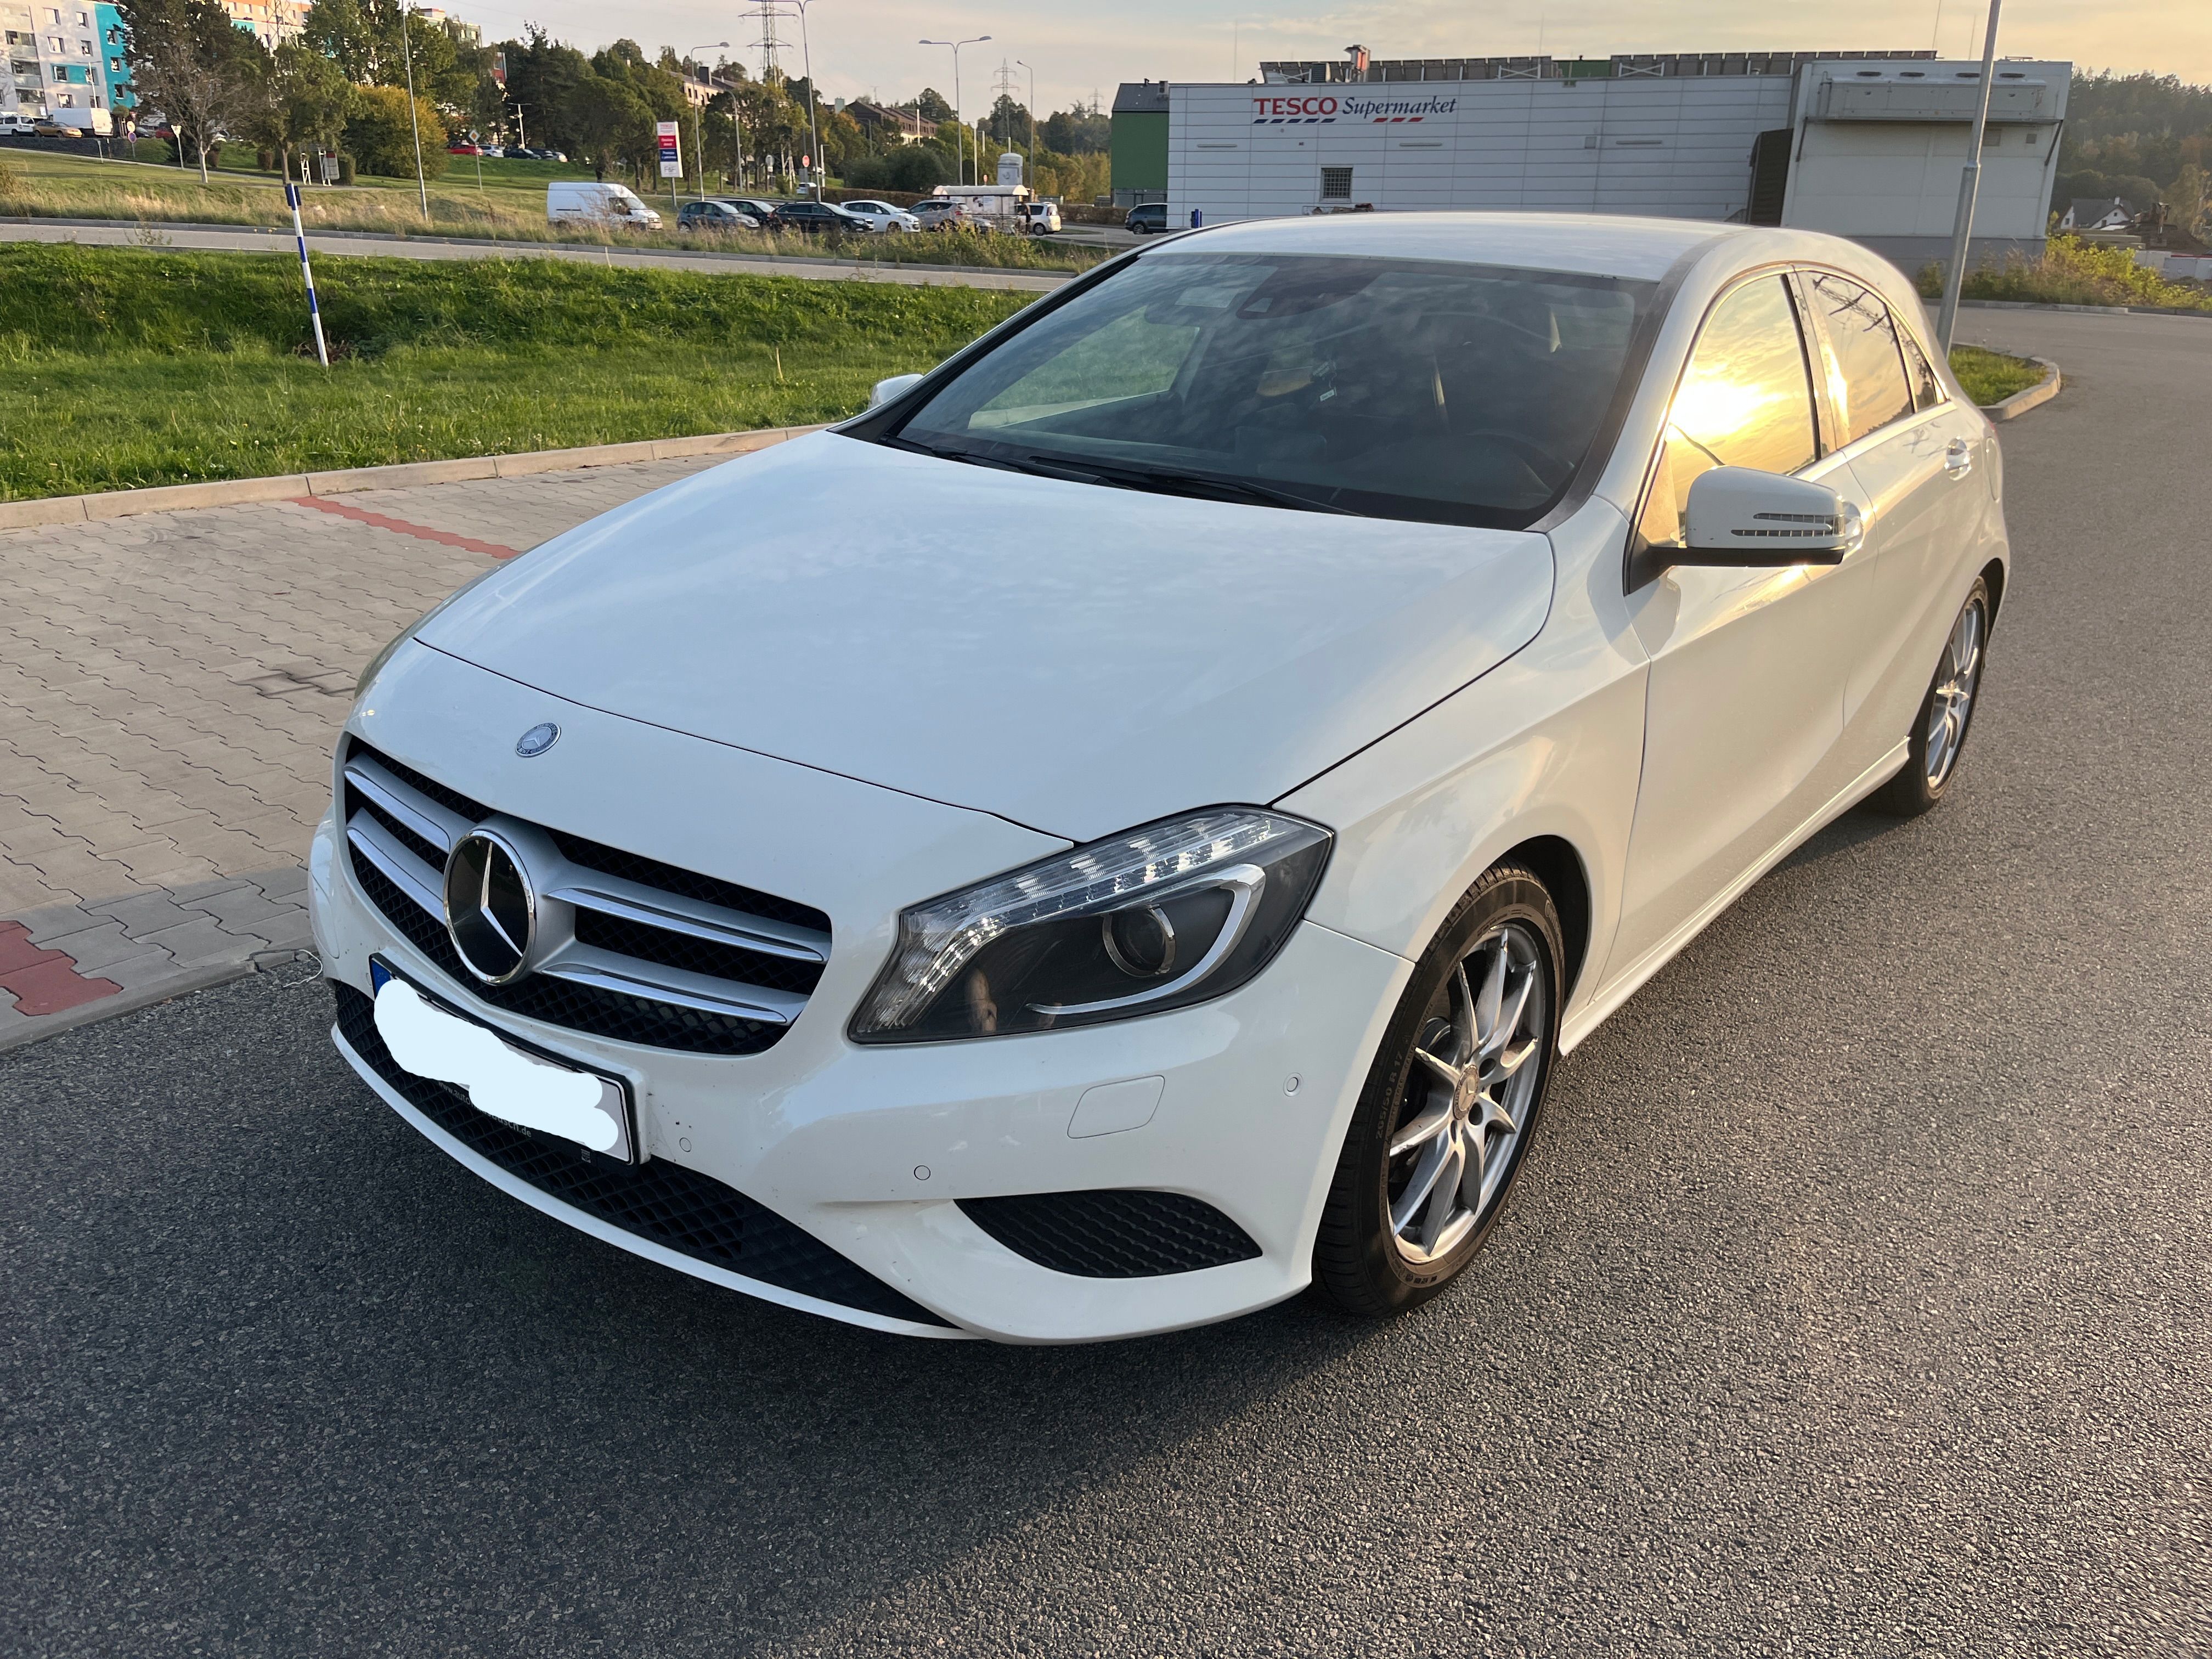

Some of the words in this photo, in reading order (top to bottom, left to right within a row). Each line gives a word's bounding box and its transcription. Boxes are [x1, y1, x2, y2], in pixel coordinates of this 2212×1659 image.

[1254, 97, 1338, 115] TESCO
[1342, 95, 1458, 119] Supermarket
[1375, 1086, 1392, 1139] 205/50
[1389, 1071, 1397, 1084] R
[1394, 1050, 1403, 1067] 17
